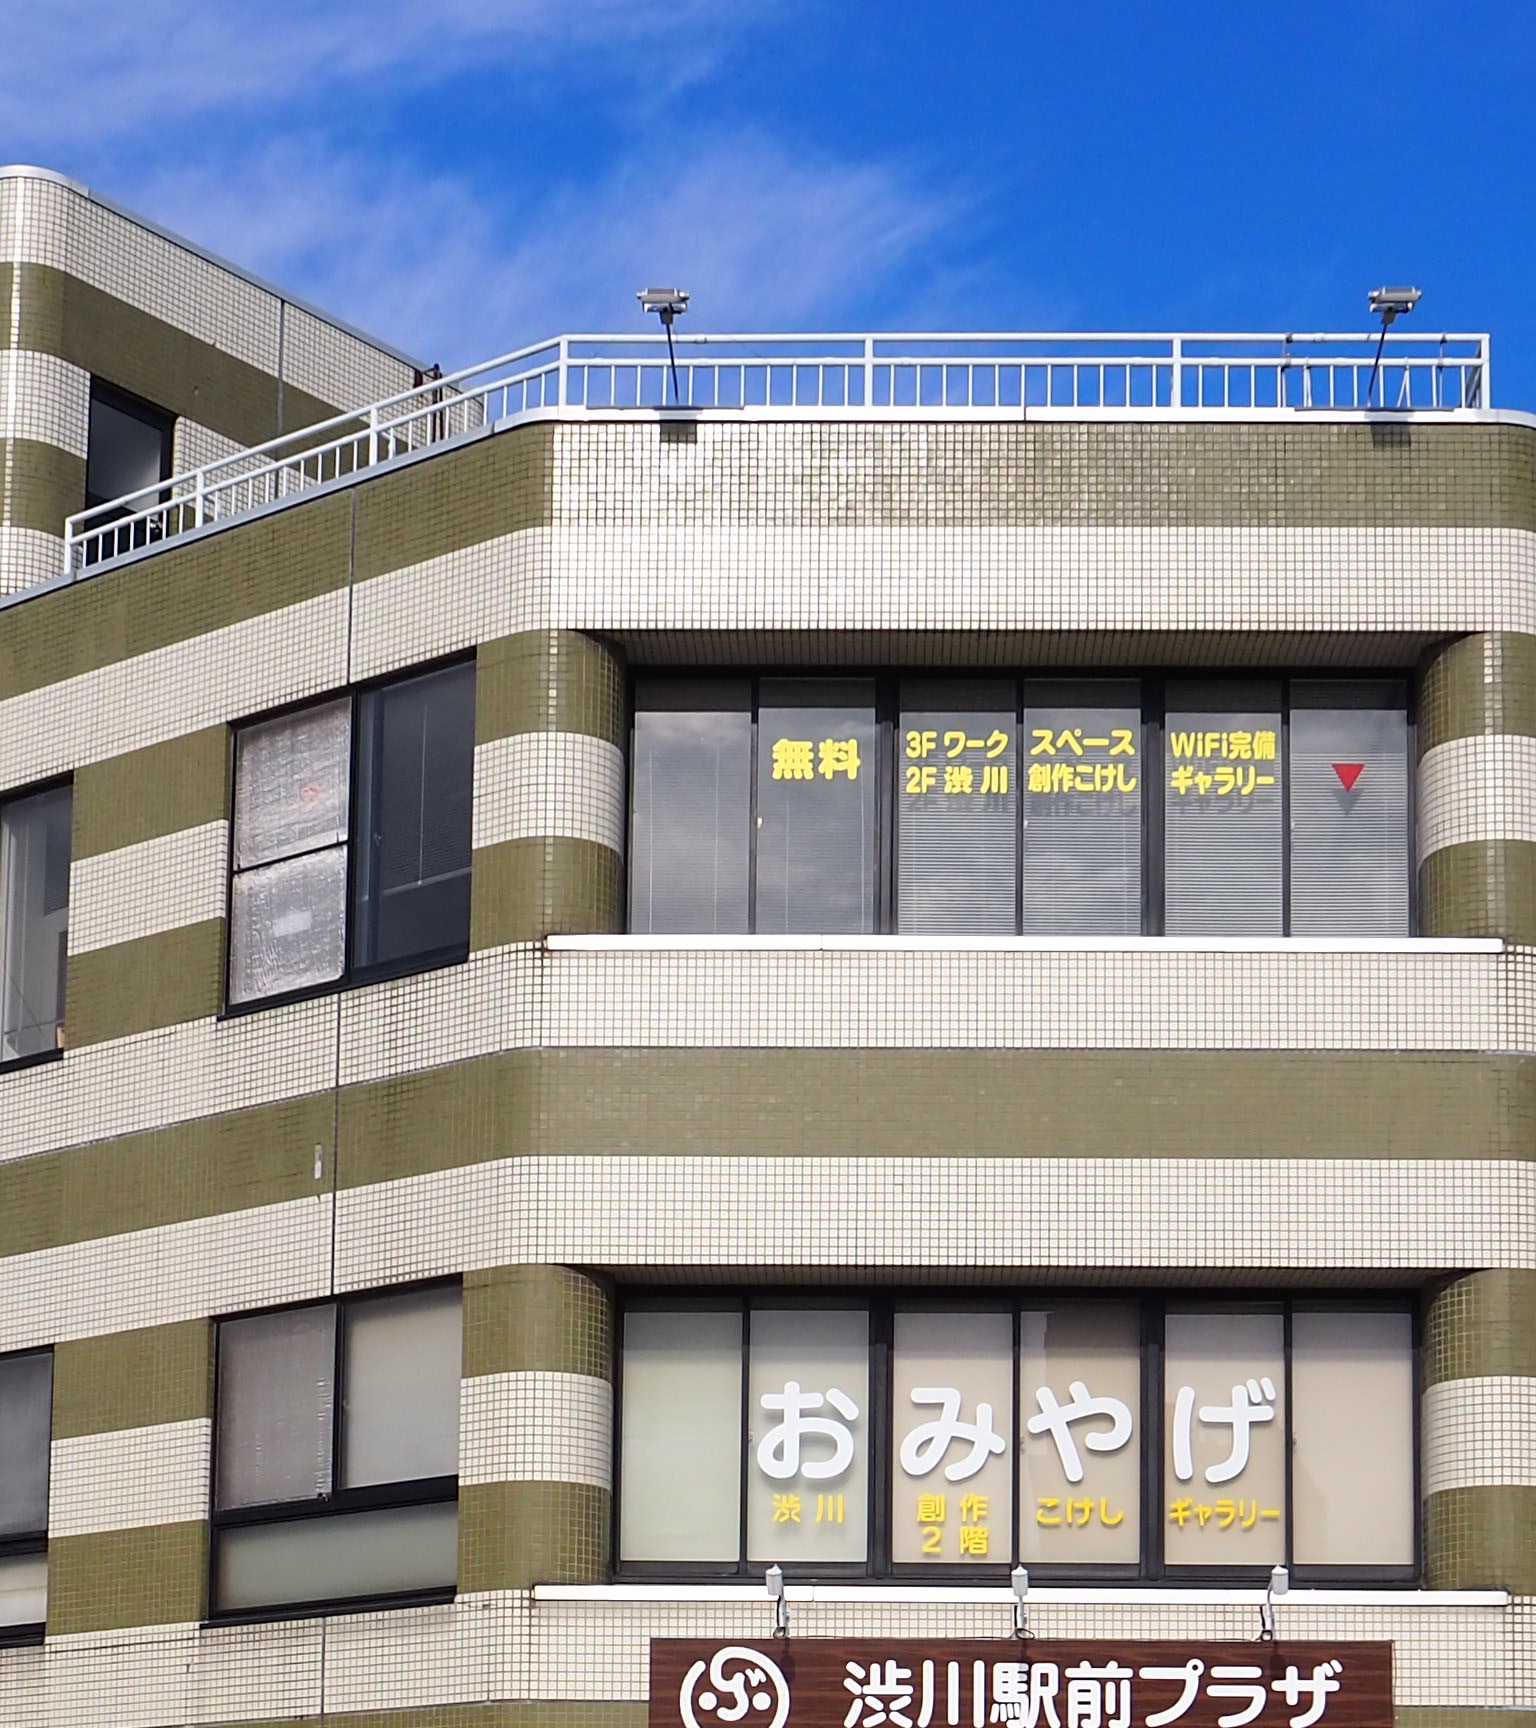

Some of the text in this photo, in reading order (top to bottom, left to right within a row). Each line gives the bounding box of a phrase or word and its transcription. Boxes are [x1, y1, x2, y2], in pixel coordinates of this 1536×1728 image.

[771, 738, 861, 781] 無料
[905, 728, 1277, 760] 3F ワーク スペース WiFi完備
[905, 763, 1276, 797] 2F 渋川 創作こけし ギャラリー
[757, 1378, 1277, 1484] おみやげ
[771, 1492, 1281, 1530] 渋川 創作 こけし ギャラリー
[921, 1525, 989, 1555] 2階
